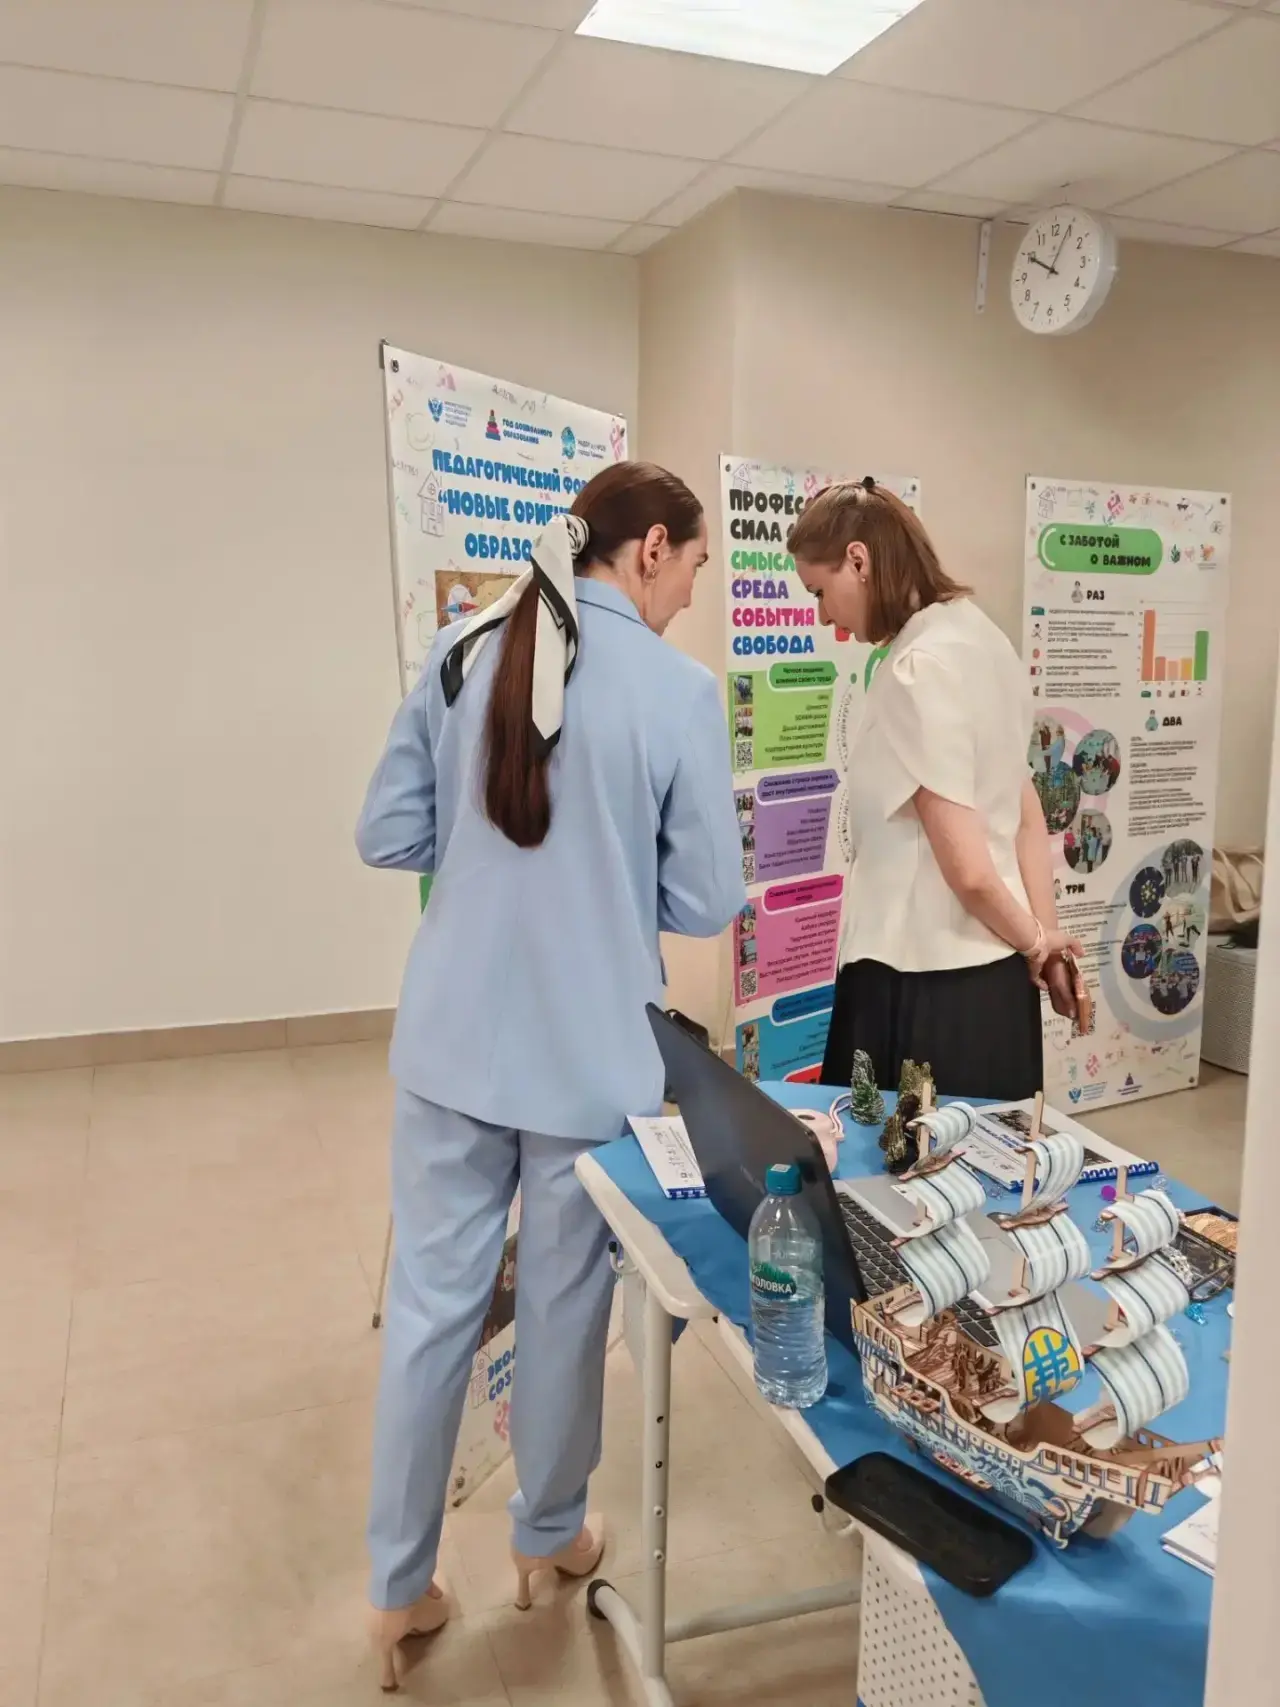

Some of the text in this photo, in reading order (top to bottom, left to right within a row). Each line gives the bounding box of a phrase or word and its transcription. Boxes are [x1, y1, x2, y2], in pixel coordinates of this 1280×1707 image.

[1051, 224, 1060, 236] 12
[1038, 233, 1046, 246] 11
[1076, 237, 1083, 249] 2
[1080, 256, 1086, 268] 3
[1021, 272, 1028, 284] 9
[1074, 276, 1080, 288] 4
[1024, 289, 1031, 301] 8
[1064, 294, 1071, 306] 5
[1046, 305, 1053, 316] 6
[502, 418, 553, 438] ГОД ДОШКОЛЬНОГО
[432, 449, 561, 493] ПЕДАГОГИЧЕСКИЙ
[729, 489, 804, 515] ПРОФЕС
[731, 518, 782, 542] СИЛА
[465, 532, 532, 562] ОБРАЗО
[1060, 533, 1120, 549] С ЗАБОТОЙ
[731, 550, 796, 572] СМЫСЛ
[1090, 554, 1151, 567] О ВАЖНОМ
[731, 579, 789, 600] СРЕДА
[1086, 590, 1105, 601] РАЗ
[732, 607, 815, 627] СОБЫТИЯ
[733, 635, 815, 656] СВОБОДА
[1162, 716, 1183, 727] ДВА
[1065, 883, 1085, 896] ТРИ
